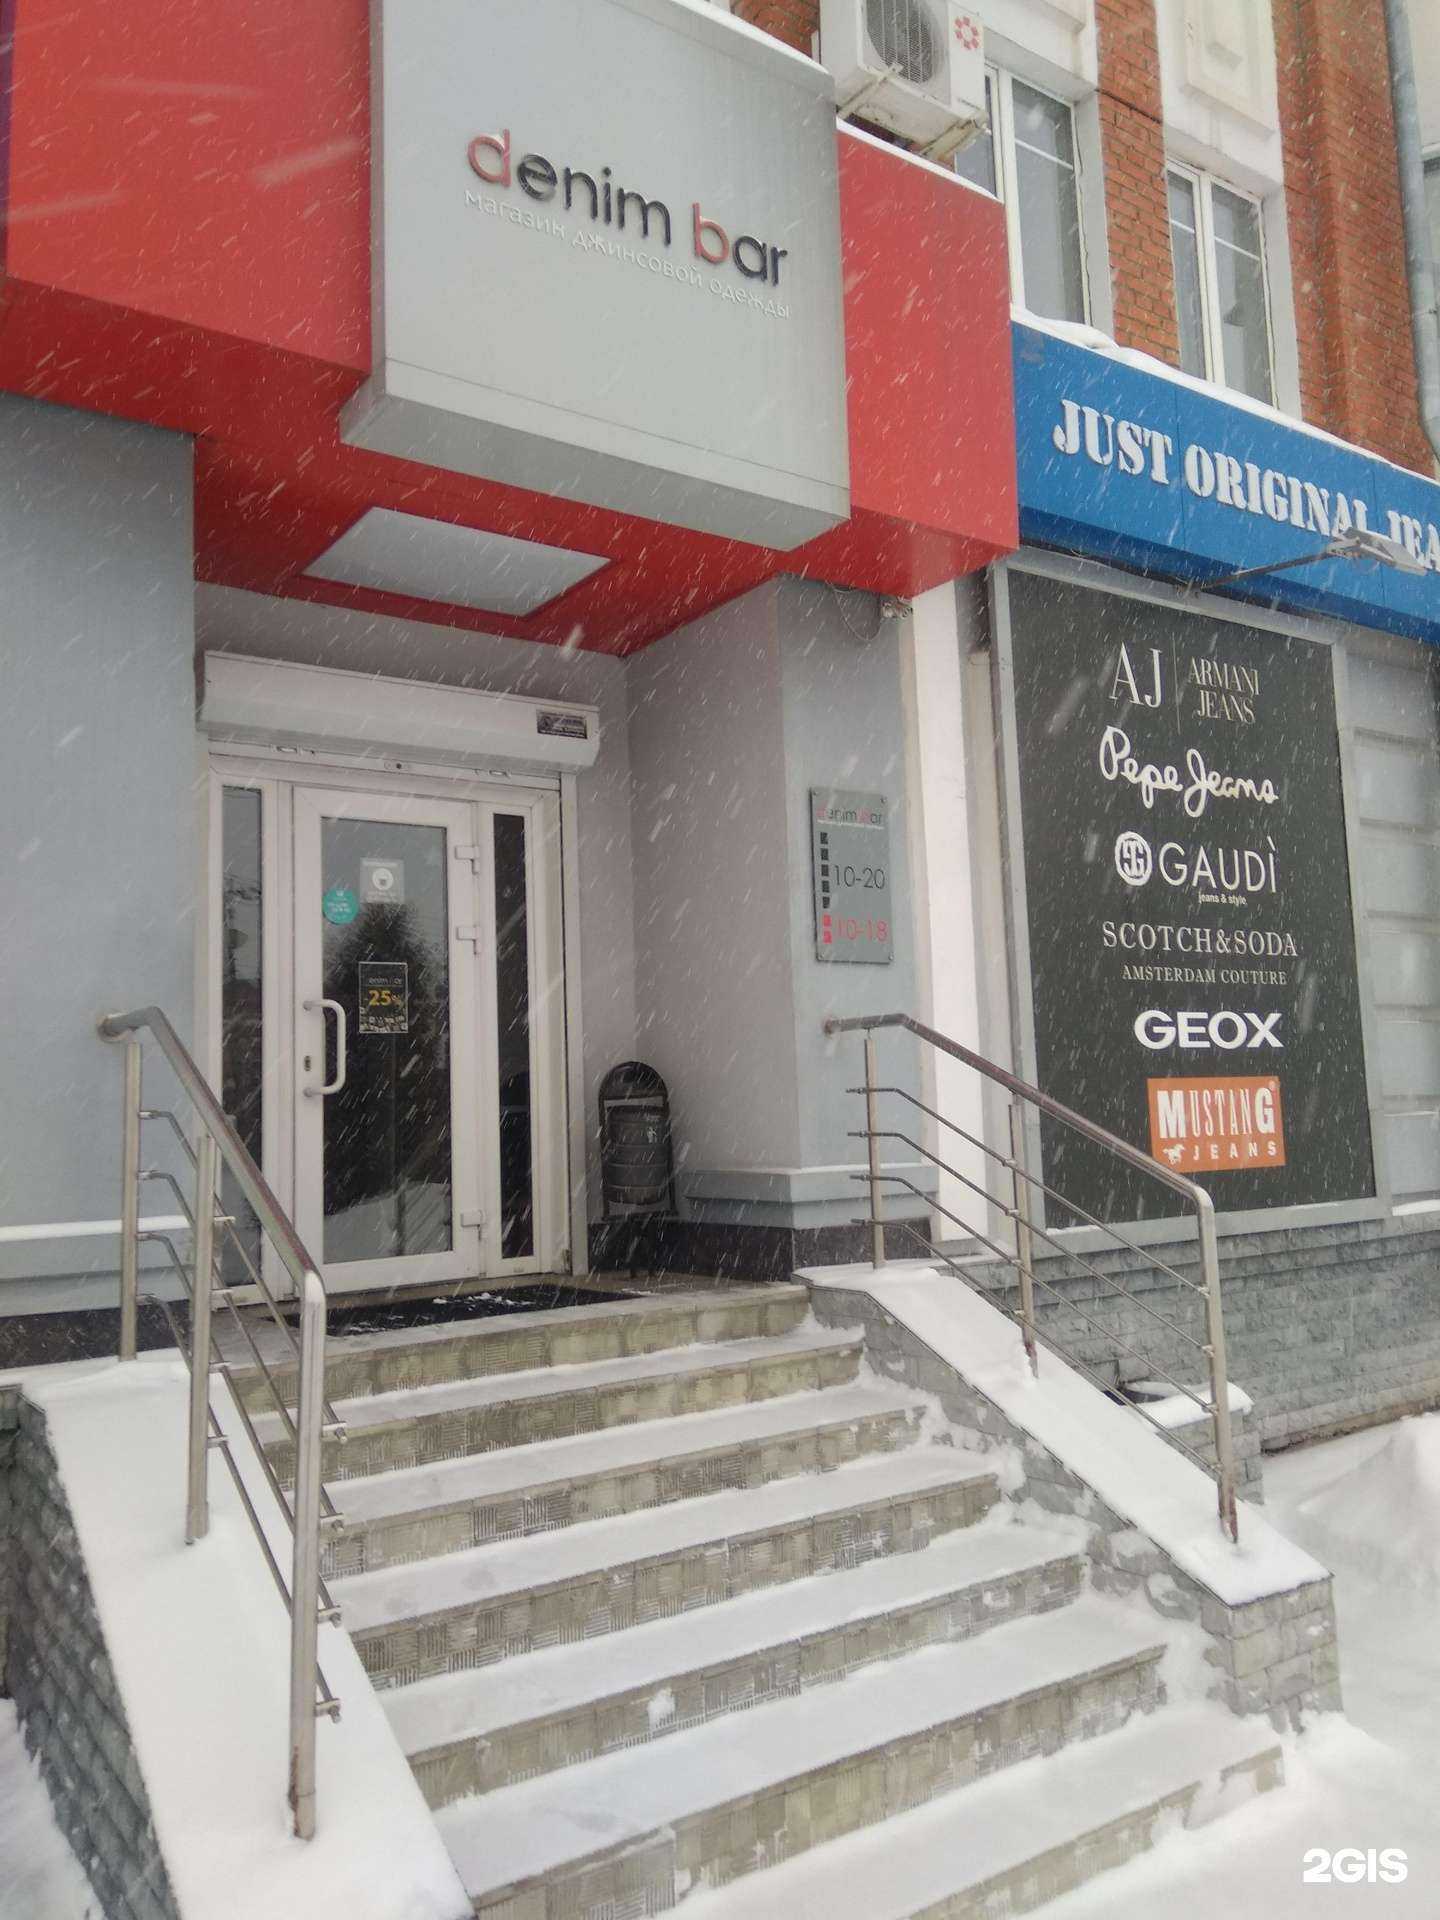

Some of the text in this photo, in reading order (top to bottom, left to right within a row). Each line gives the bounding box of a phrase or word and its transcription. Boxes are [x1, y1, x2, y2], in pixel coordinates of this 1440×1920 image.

[467, 128, 788, 287] denim bar
[572, 230, 702, 289] джинсовой
[709, 278, 791, 320] одежды
[1053, 399, 1173, 485] JUST
[1109, 641, 1163, 708] AJ
[1188, 655, 1260, 696] ARMANI
[1197, 689, 1255, 724] JEANS
[1099, 725, 1279, 818] Pepe Jeans
[834, 864, 885, 890] 10-20
[837, 918, 889, 943] 10-18
[1102, 921, 1298, 957] SCOTCH&SODA
[1122, 965, 1288, 986] AMSTERDAM COUTURE
[1134, 1009, 1284, 1050] GEOX
[1156, 1086, 1276, 1139] MUSTANG
[1193, 1140, 1277, 1161] JEANS
